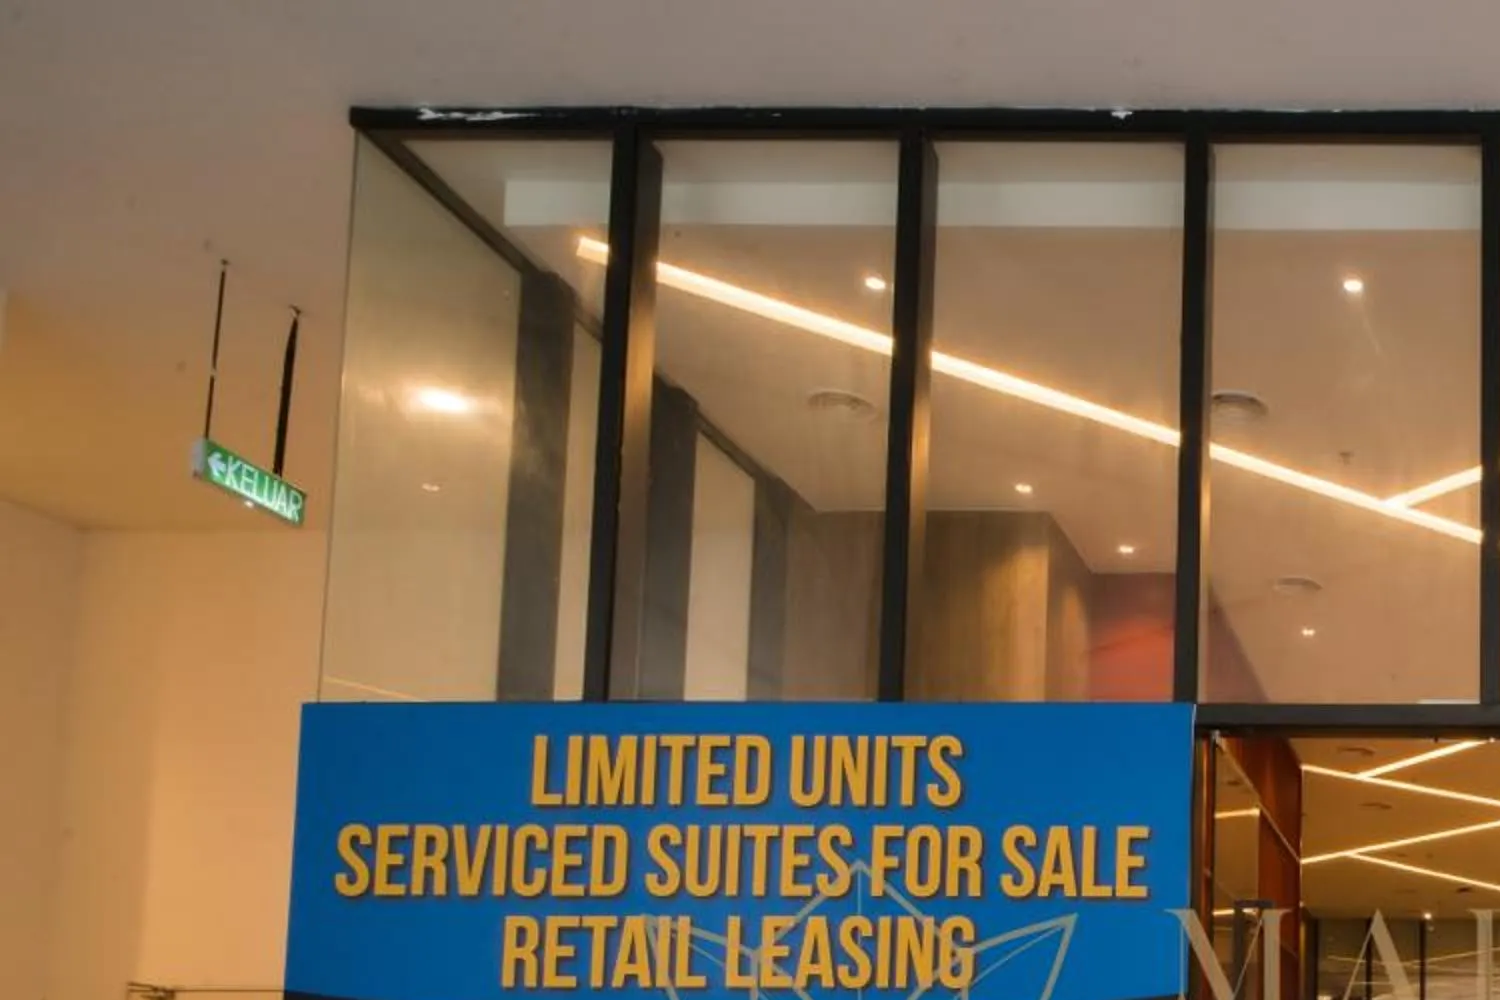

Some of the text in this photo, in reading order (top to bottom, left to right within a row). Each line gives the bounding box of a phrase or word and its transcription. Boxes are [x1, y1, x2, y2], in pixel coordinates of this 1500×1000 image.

[224, 455, 303, 522] KELUAR
[530, 734, 963, 808] LIMITED UNITS
[333, 823, 1150, 899] SERVICED SUITES FOR SALE
[500, 915, 977, 990] RETAIL LEASING
